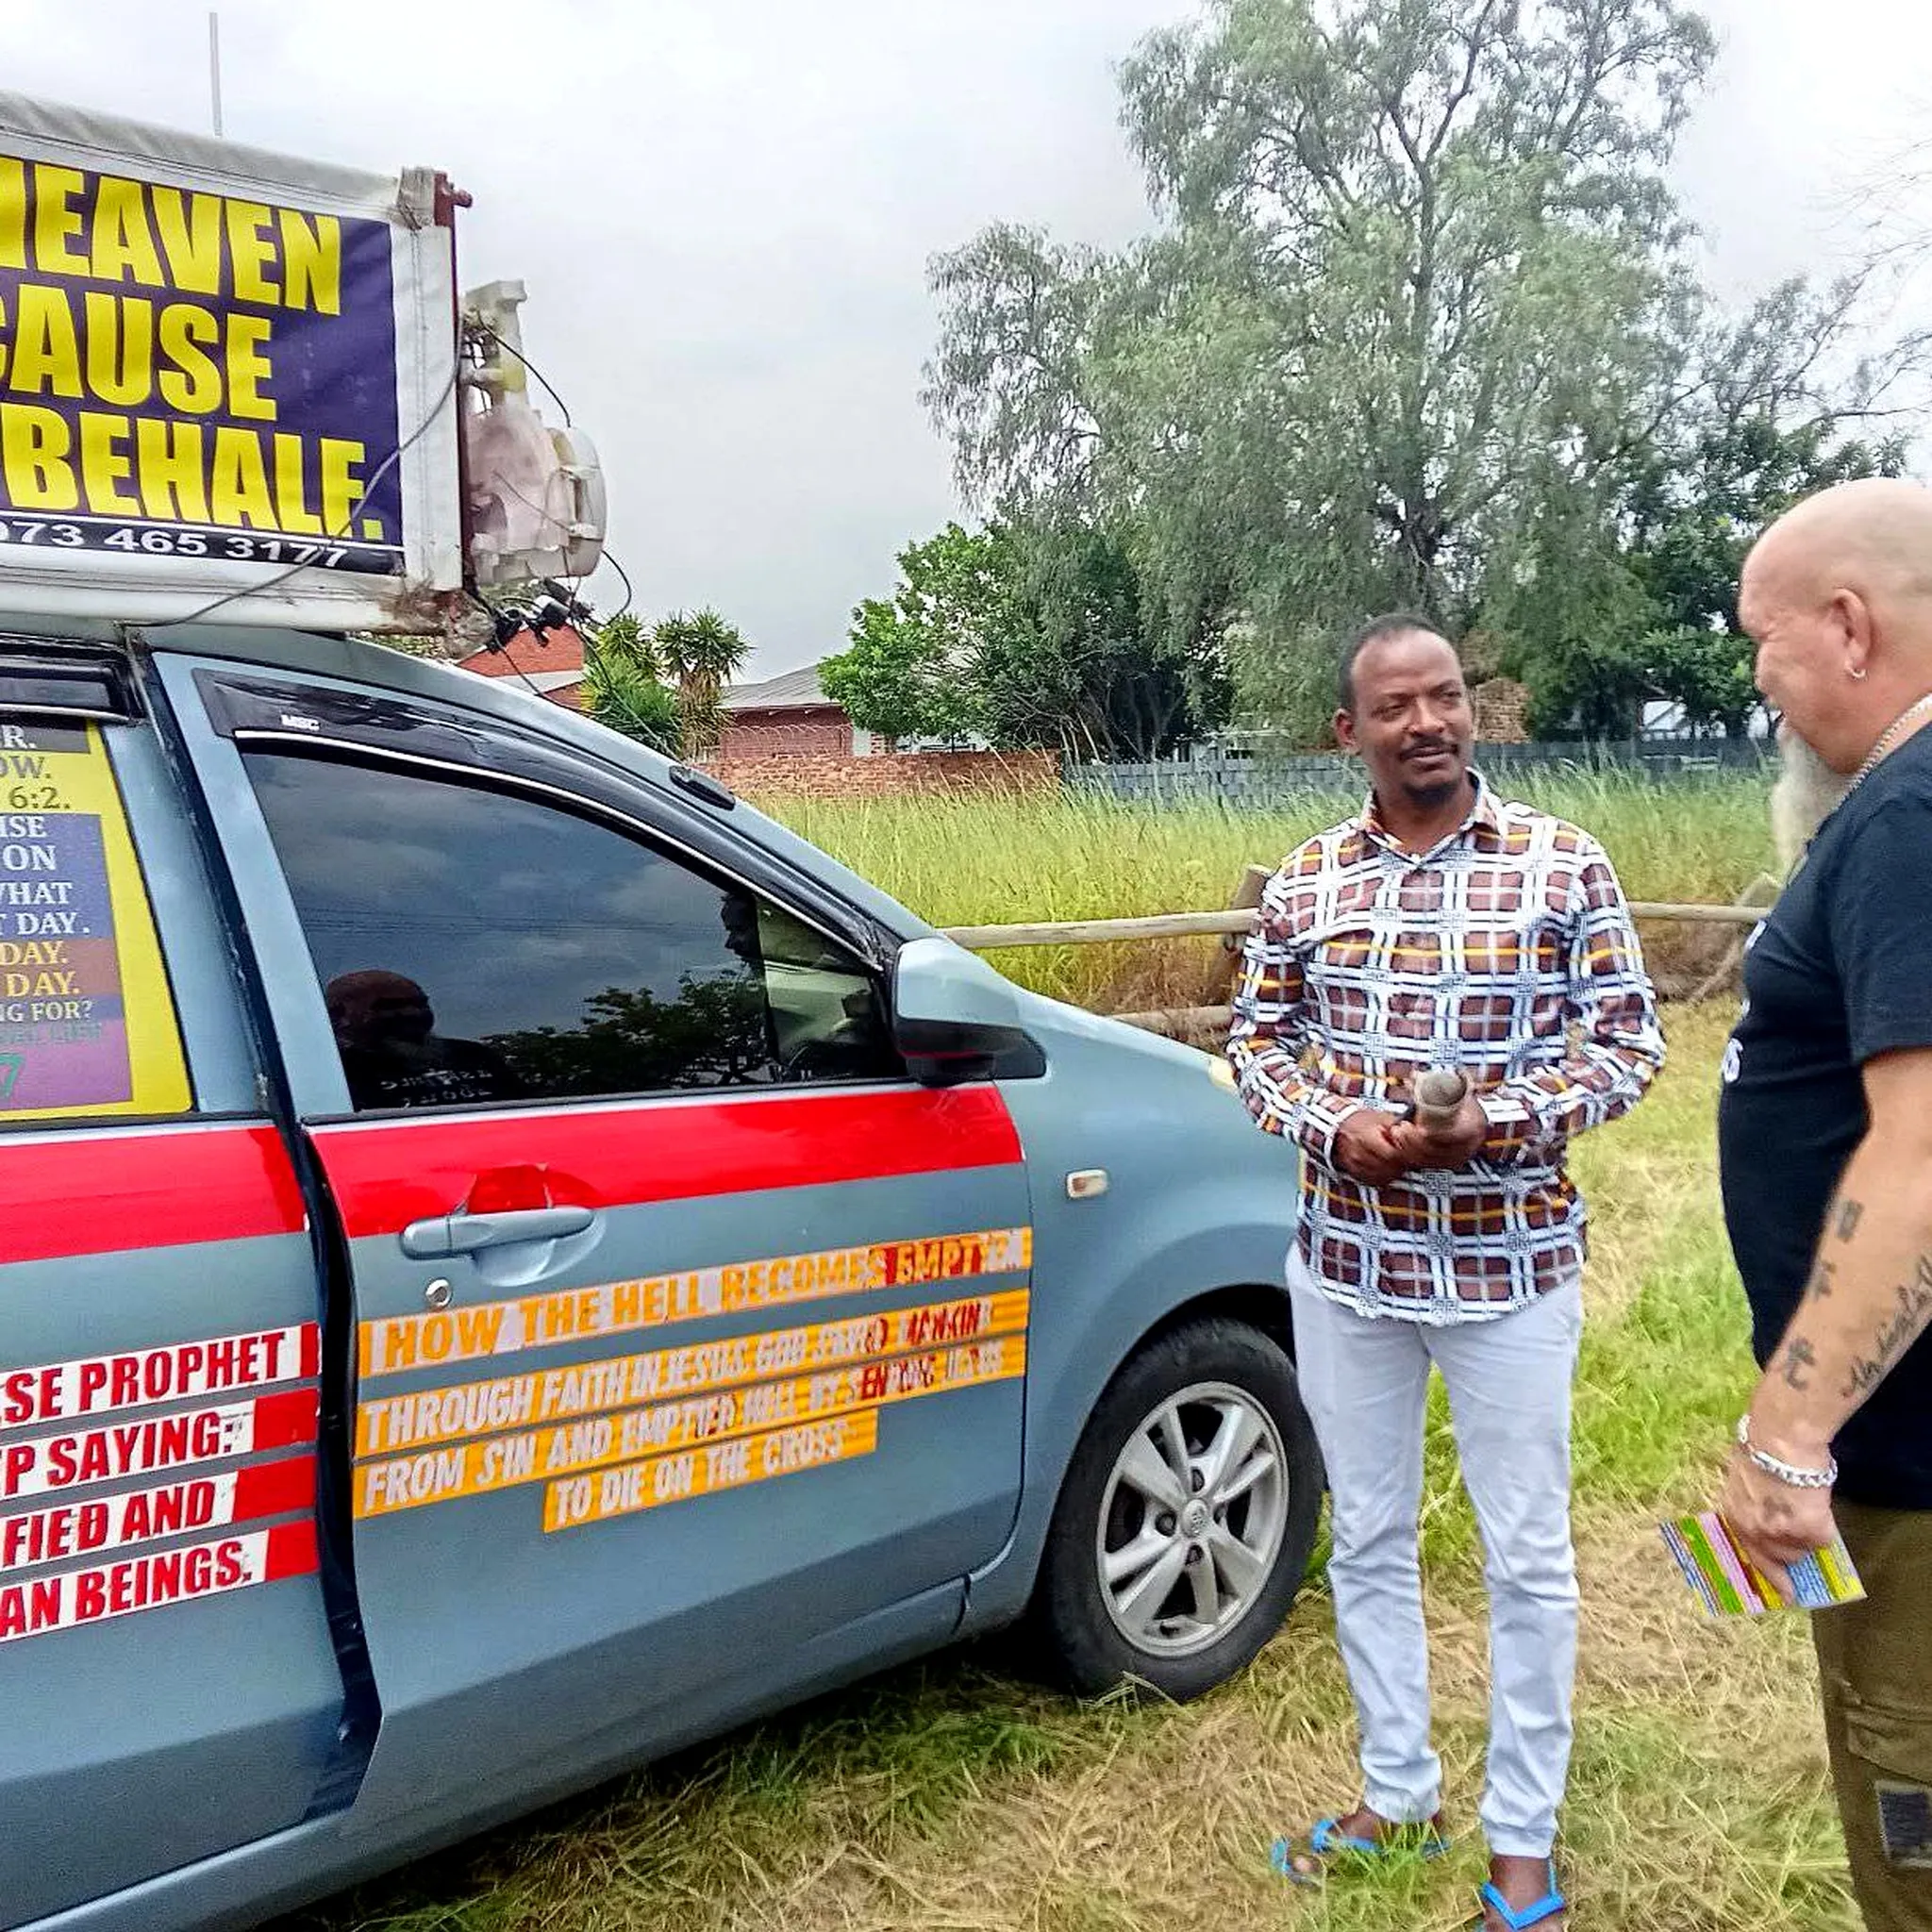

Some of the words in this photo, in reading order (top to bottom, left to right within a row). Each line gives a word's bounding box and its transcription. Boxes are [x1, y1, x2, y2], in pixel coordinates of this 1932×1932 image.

[0, 284, 276, 420] AUSE
[1, 402, 383, 540] BEHALF.
[104, 528, 208, 556] 465
[225, 538, 347, 567] 3177
[9, 786, 70, 809] 6:2.
[0, 882, 73, 906] HAT
[3, 843, 57, 871] ON
[0, 941, 68, 966] DAY.
[15, 911, 91, 935] DAY.
[5, 971, 80, 997] DAY.
[31, 1000, 92, 1023] FOR?
[385, 1307, 507, 1369] HOW
[519, 1290, 600, 1342] THE
[613, 1274, 702, 1324] HELL
[722, 1247, 887, 1311] BECOMES
[5, 1368, 62, 1424] SE
[79, 1331, 285, 1412] PROPHET
[365, 1376, 534, 1450] THROUGH
[541, 1358, 627, 1416] FAITH
[47, 1411, 234, 1487] SAYING:
[364, 1447, 468, 1512] FROM
[476, 1434, 538, 1485] SIN
[547, 1420, 612, 1471] AND
[554, 1476, 592, 1525] TO
[600, 1465, 645, 1512] DIE
[654, 1454, 695, 1499] ON
[708, 1439, 752, 1487] THE
[762, 1419, 848, 1476] CROSS
[1, 1503, 109, 1567] FIED
[120, 1481, 216, 1541] AND
[75, 1541, 253, 1622] BEINGS.
